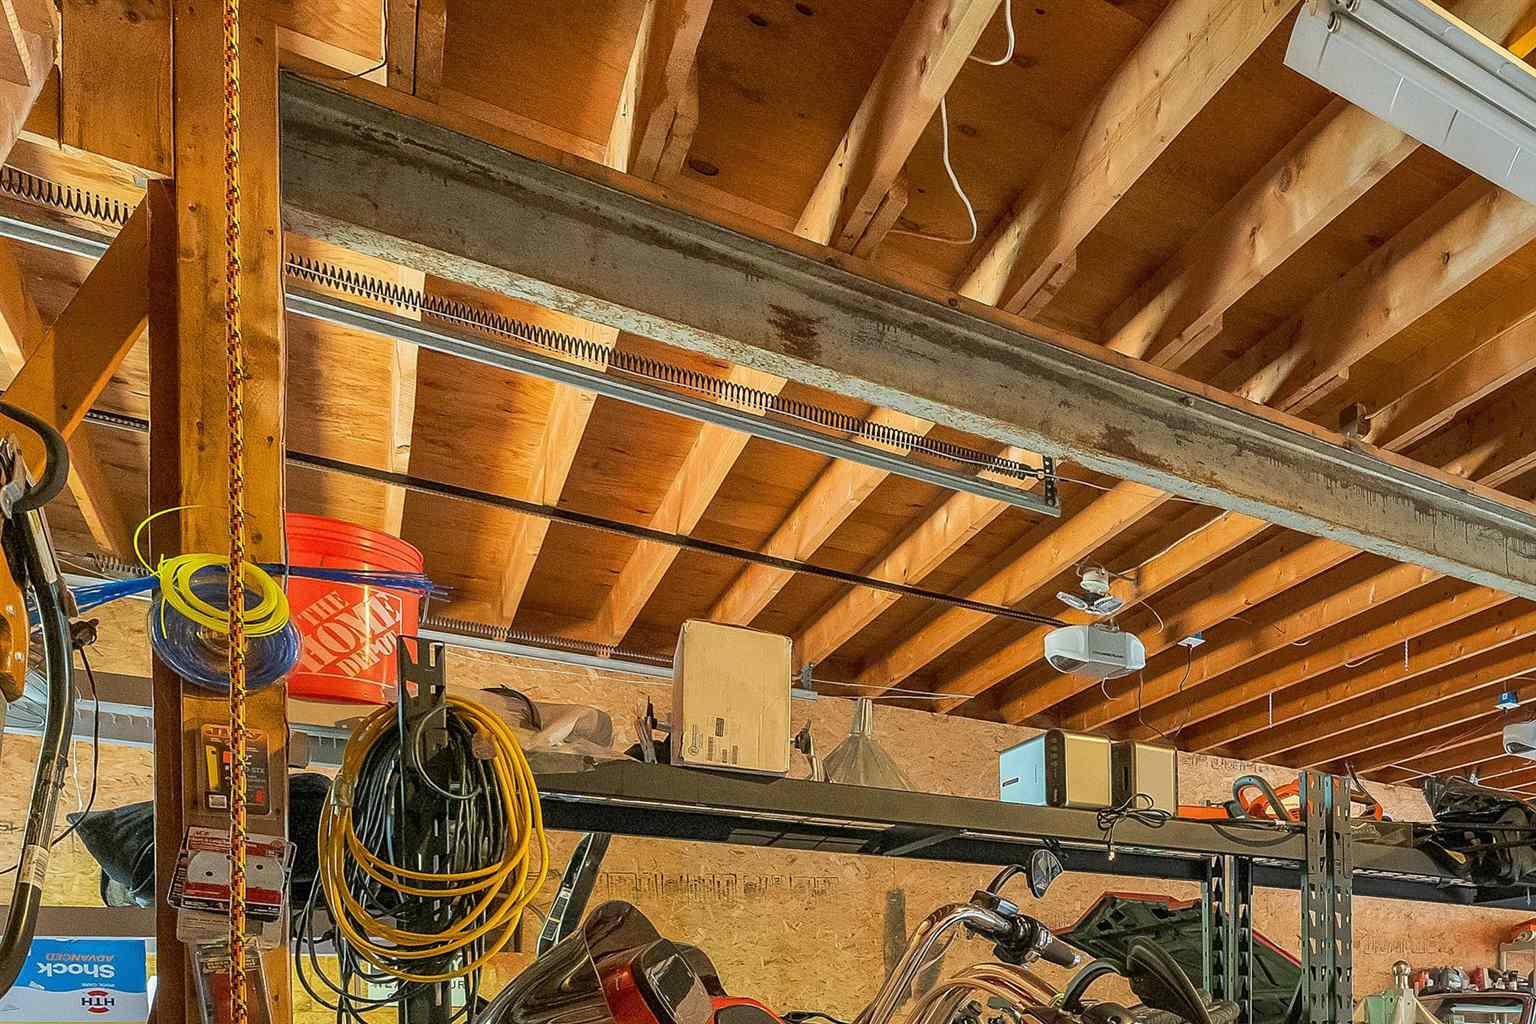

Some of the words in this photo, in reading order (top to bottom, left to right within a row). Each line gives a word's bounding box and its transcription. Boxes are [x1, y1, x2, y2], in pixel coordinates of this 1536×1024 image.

[297, 591, 350, 626] THE
[302, 593, 401, 673] HOME
[37, 962, 116, 978] Shock
[81, 997, 115, 1006] HTH
